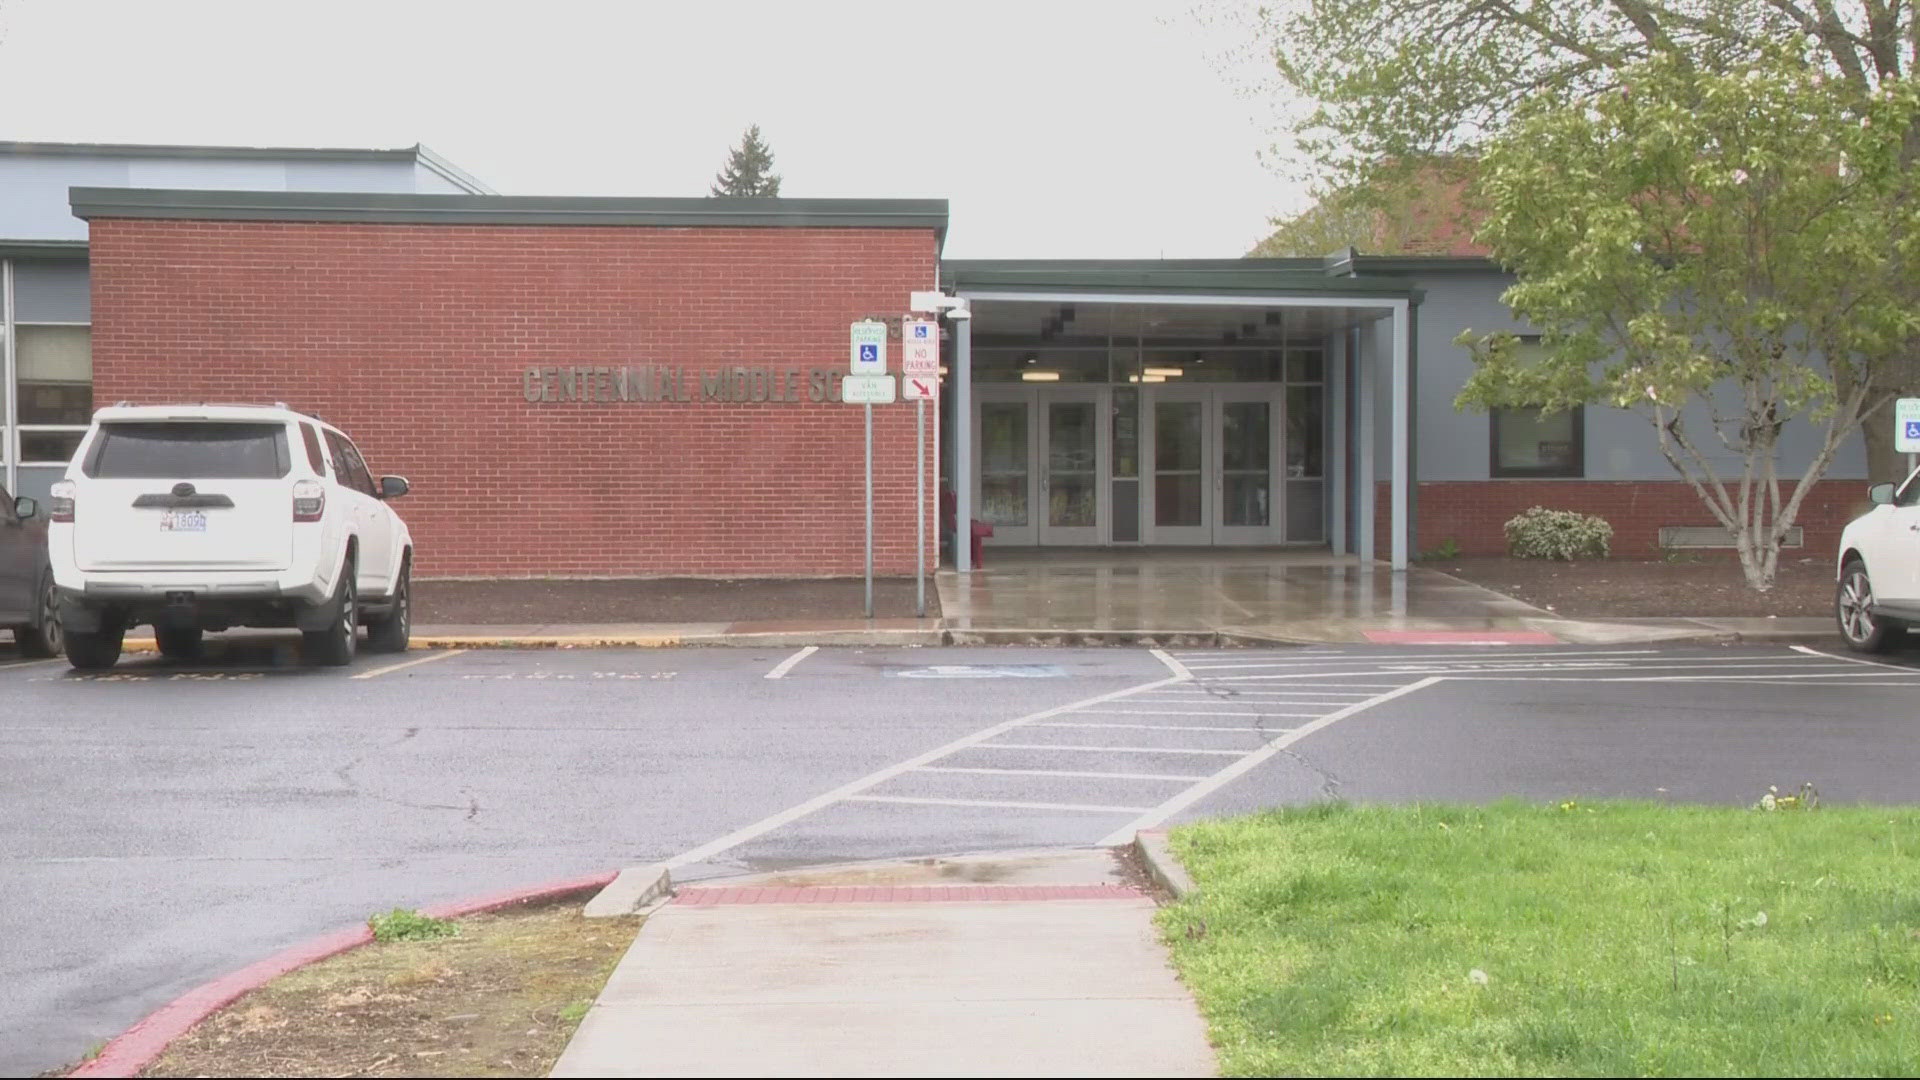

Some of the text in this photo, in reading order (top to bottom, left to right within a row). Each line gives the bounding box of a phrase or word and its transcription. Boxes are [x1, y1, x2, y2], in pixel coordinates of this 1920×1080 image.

[914, 348, 927, 359] NO
[906, 360, 936, 370] PARKING
[522, 366, 691, 403] CENTENNIAL
[699, 366, 801, 403] MIDDLE
